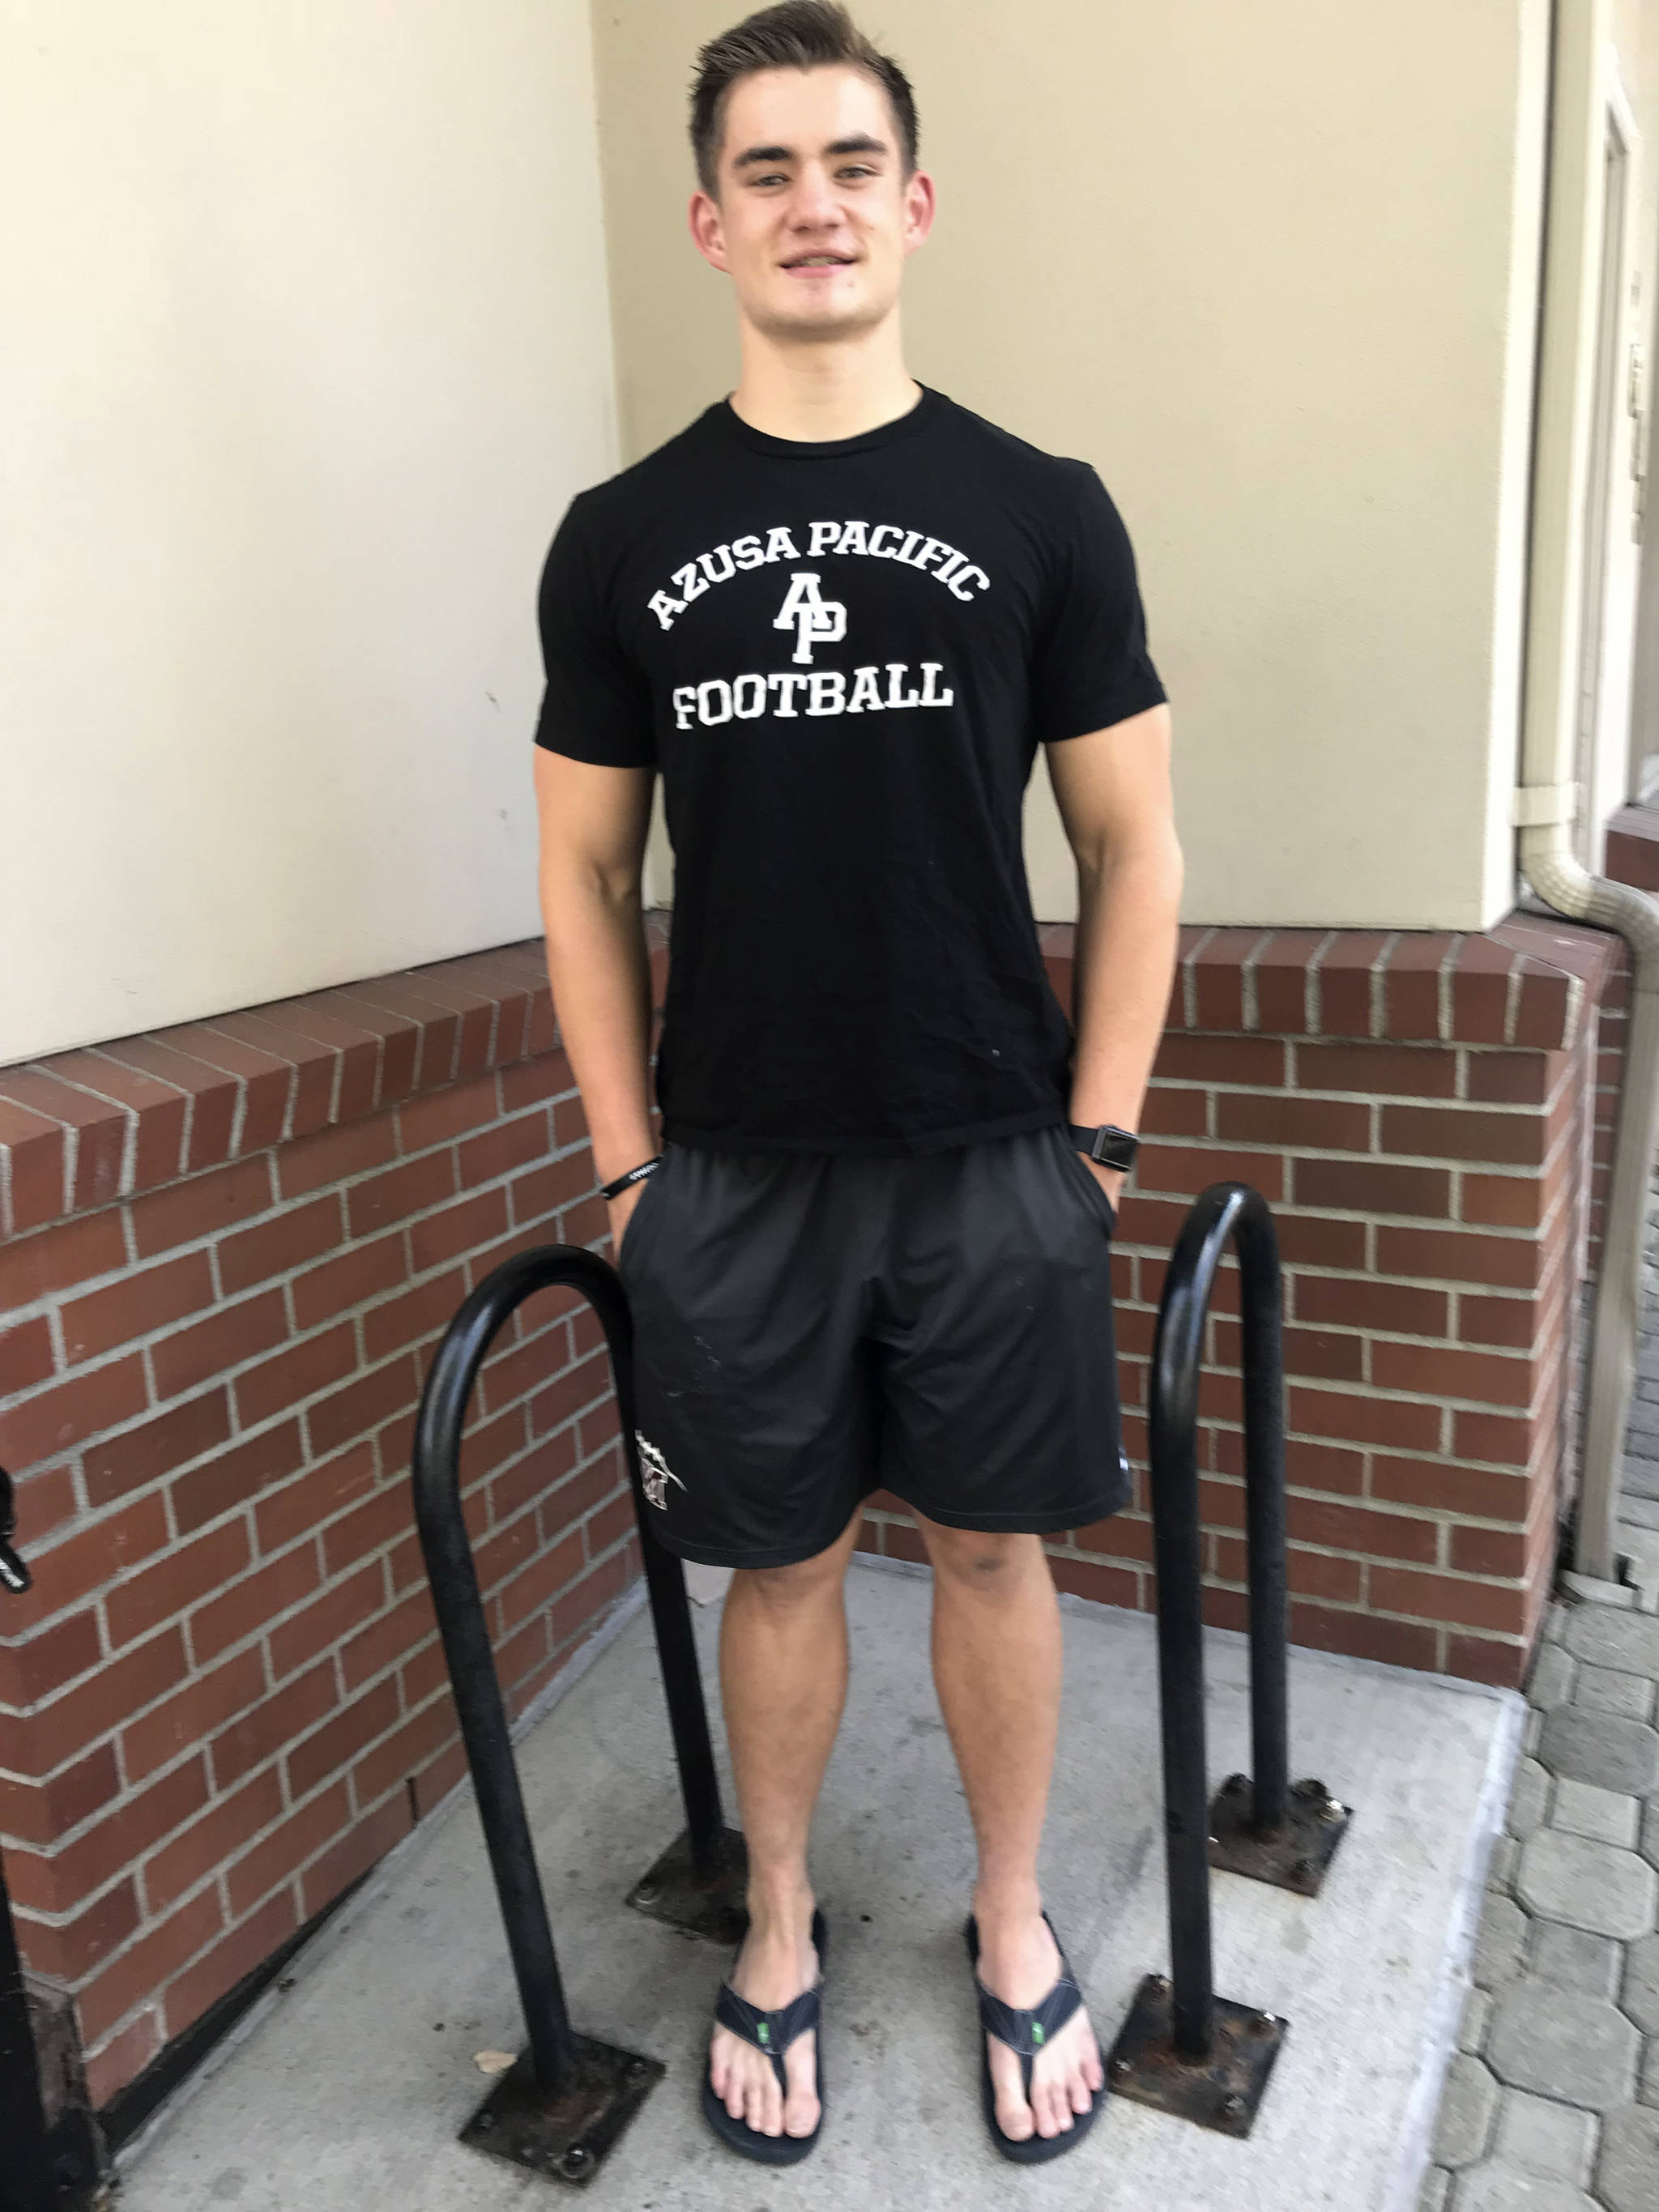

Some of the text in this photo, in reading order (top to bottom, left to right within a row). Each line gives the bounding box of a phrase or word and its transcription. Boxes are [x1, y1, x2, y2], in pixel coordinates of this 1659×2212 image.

[646, 520, 991, 631] AZUSA PACIFIC
[772, 572, 847, 665] AP
[672, 662, 954, 731] FOOTBALL
